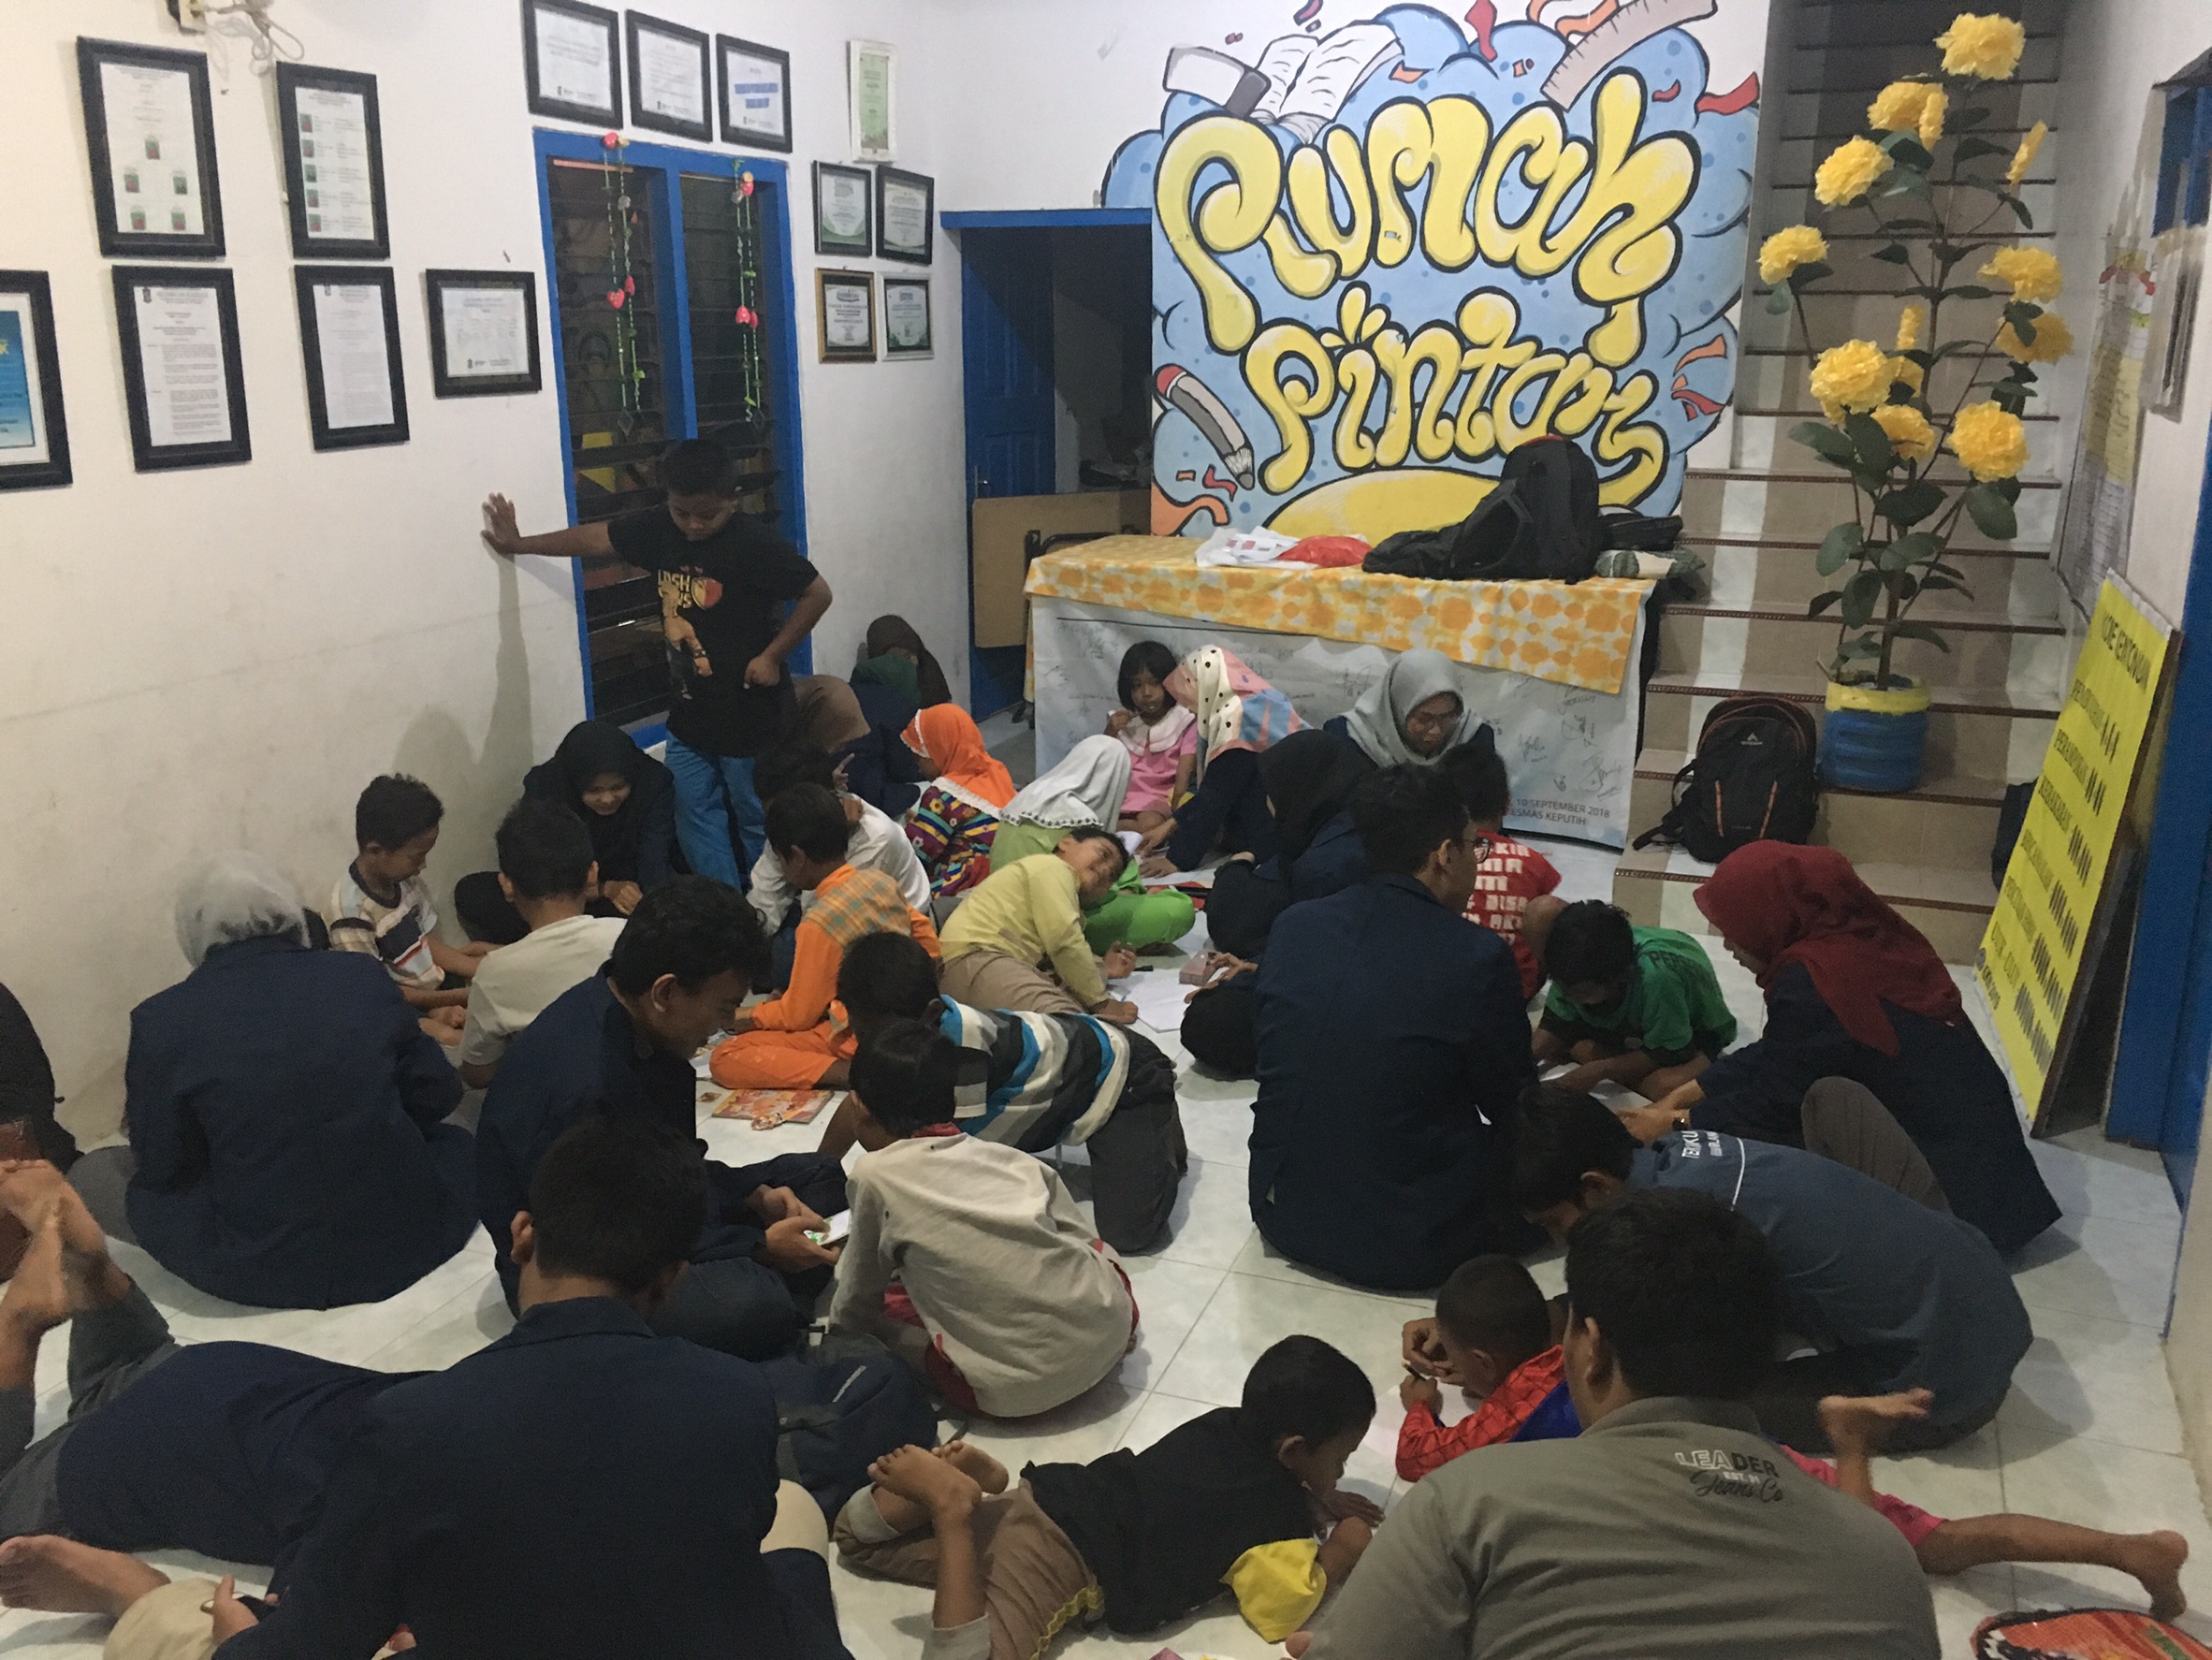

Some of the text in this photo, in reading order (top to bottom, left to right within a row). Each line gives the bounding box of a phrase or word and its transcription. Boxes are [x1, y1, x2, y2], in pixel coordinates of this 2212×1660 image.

[1157, 66, 1700, 368] Rumah
[1509, 808, 1586, 825] ESMAS KEPUTIH
[1516, 798, 1610, 819] 10 SEPTEMBER 2018
[1674, 1449, 1780, 1478] LEADER
